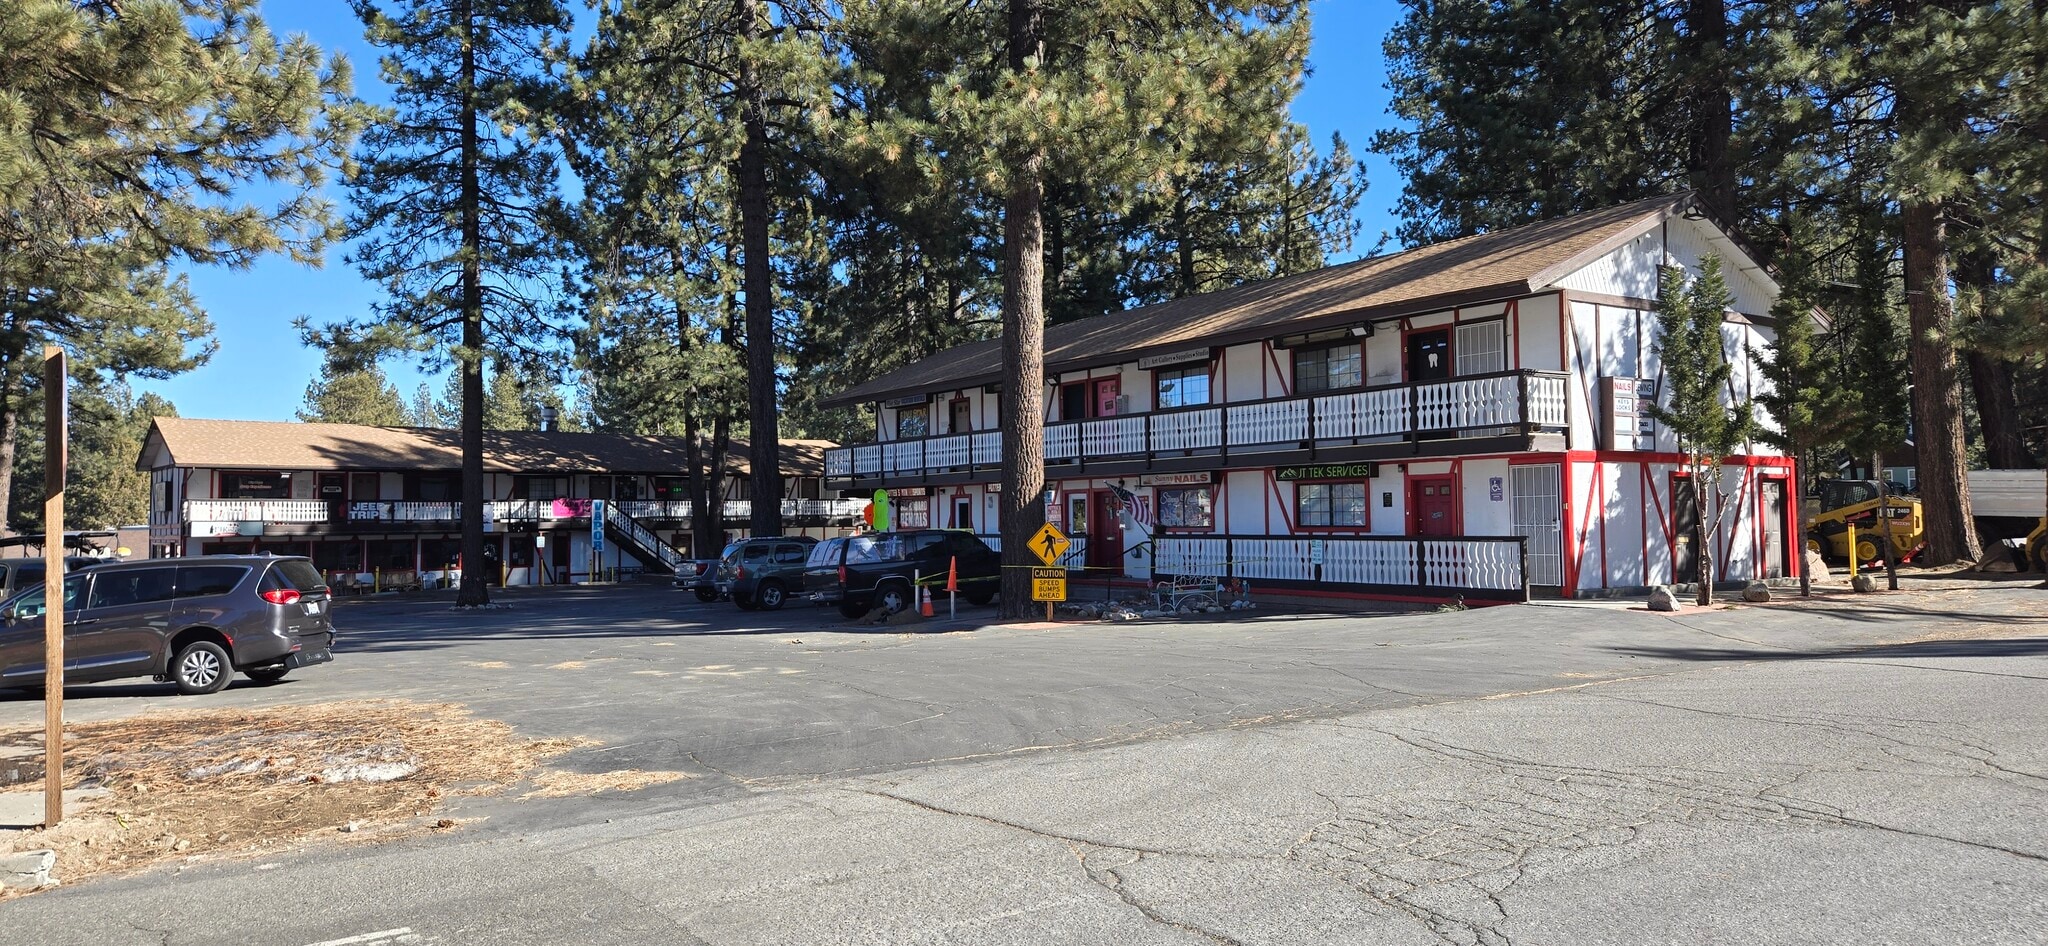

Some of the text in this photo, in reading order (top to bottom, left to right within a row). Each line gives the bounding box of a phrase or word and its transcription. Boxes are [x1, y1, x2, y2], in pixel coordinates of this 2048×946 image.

[1175, 351, 1193, 361] Supplies
[1615, 382, 1631, 390] NAILS
[1309, 467, 1324, 478] TEK
[1326, 465, 1368, 477] SERVICES
[1174, 474, 1208, 482] NAILS
[353, 502, 385, 511] JEEP
[349, 511, 388, 519] TRIPS
[900, 512, 927, 528] RENTALS
[593, 501, 604, 550] VAPOR
[1034, 569, 1064, 577] CAUTION
